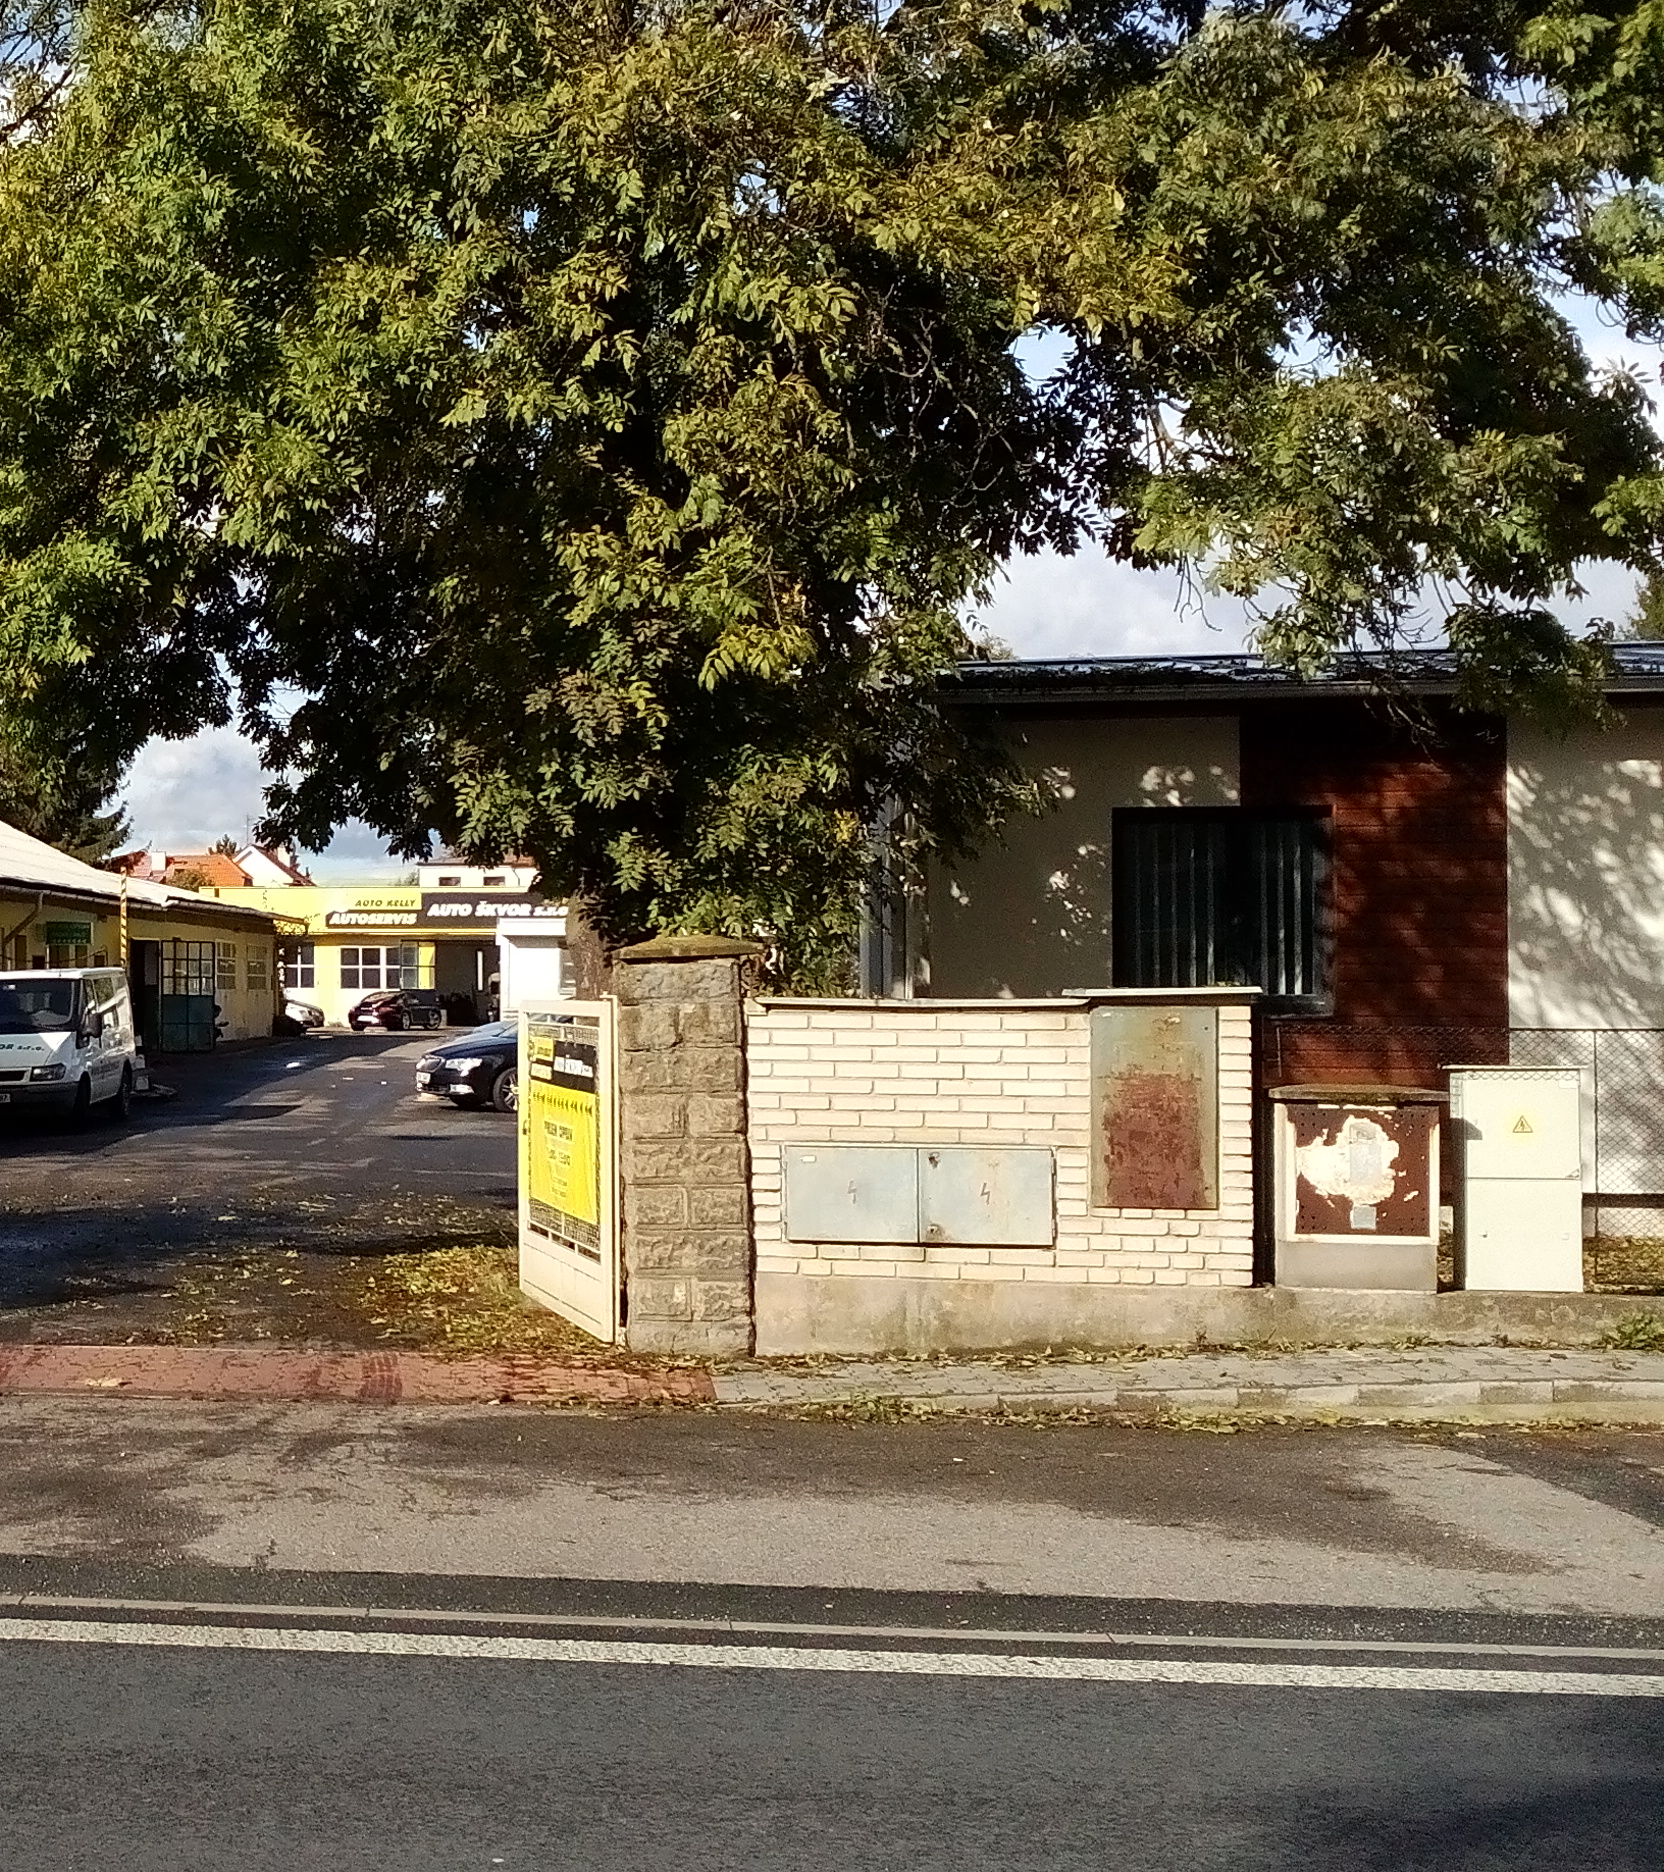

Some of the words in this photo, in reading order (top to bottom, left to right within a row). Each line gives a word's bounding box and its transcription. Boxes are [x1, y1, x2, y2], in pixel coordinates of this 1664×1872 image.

[354, 899, 383, 907] AUTO
[386, 899, 416, 907] KELLY
[427, 903, 472, 917] AUTO
[474, 900, 532, 917] ŠKVOR
[329, 913, 417, 925] AUTOSERVIS
